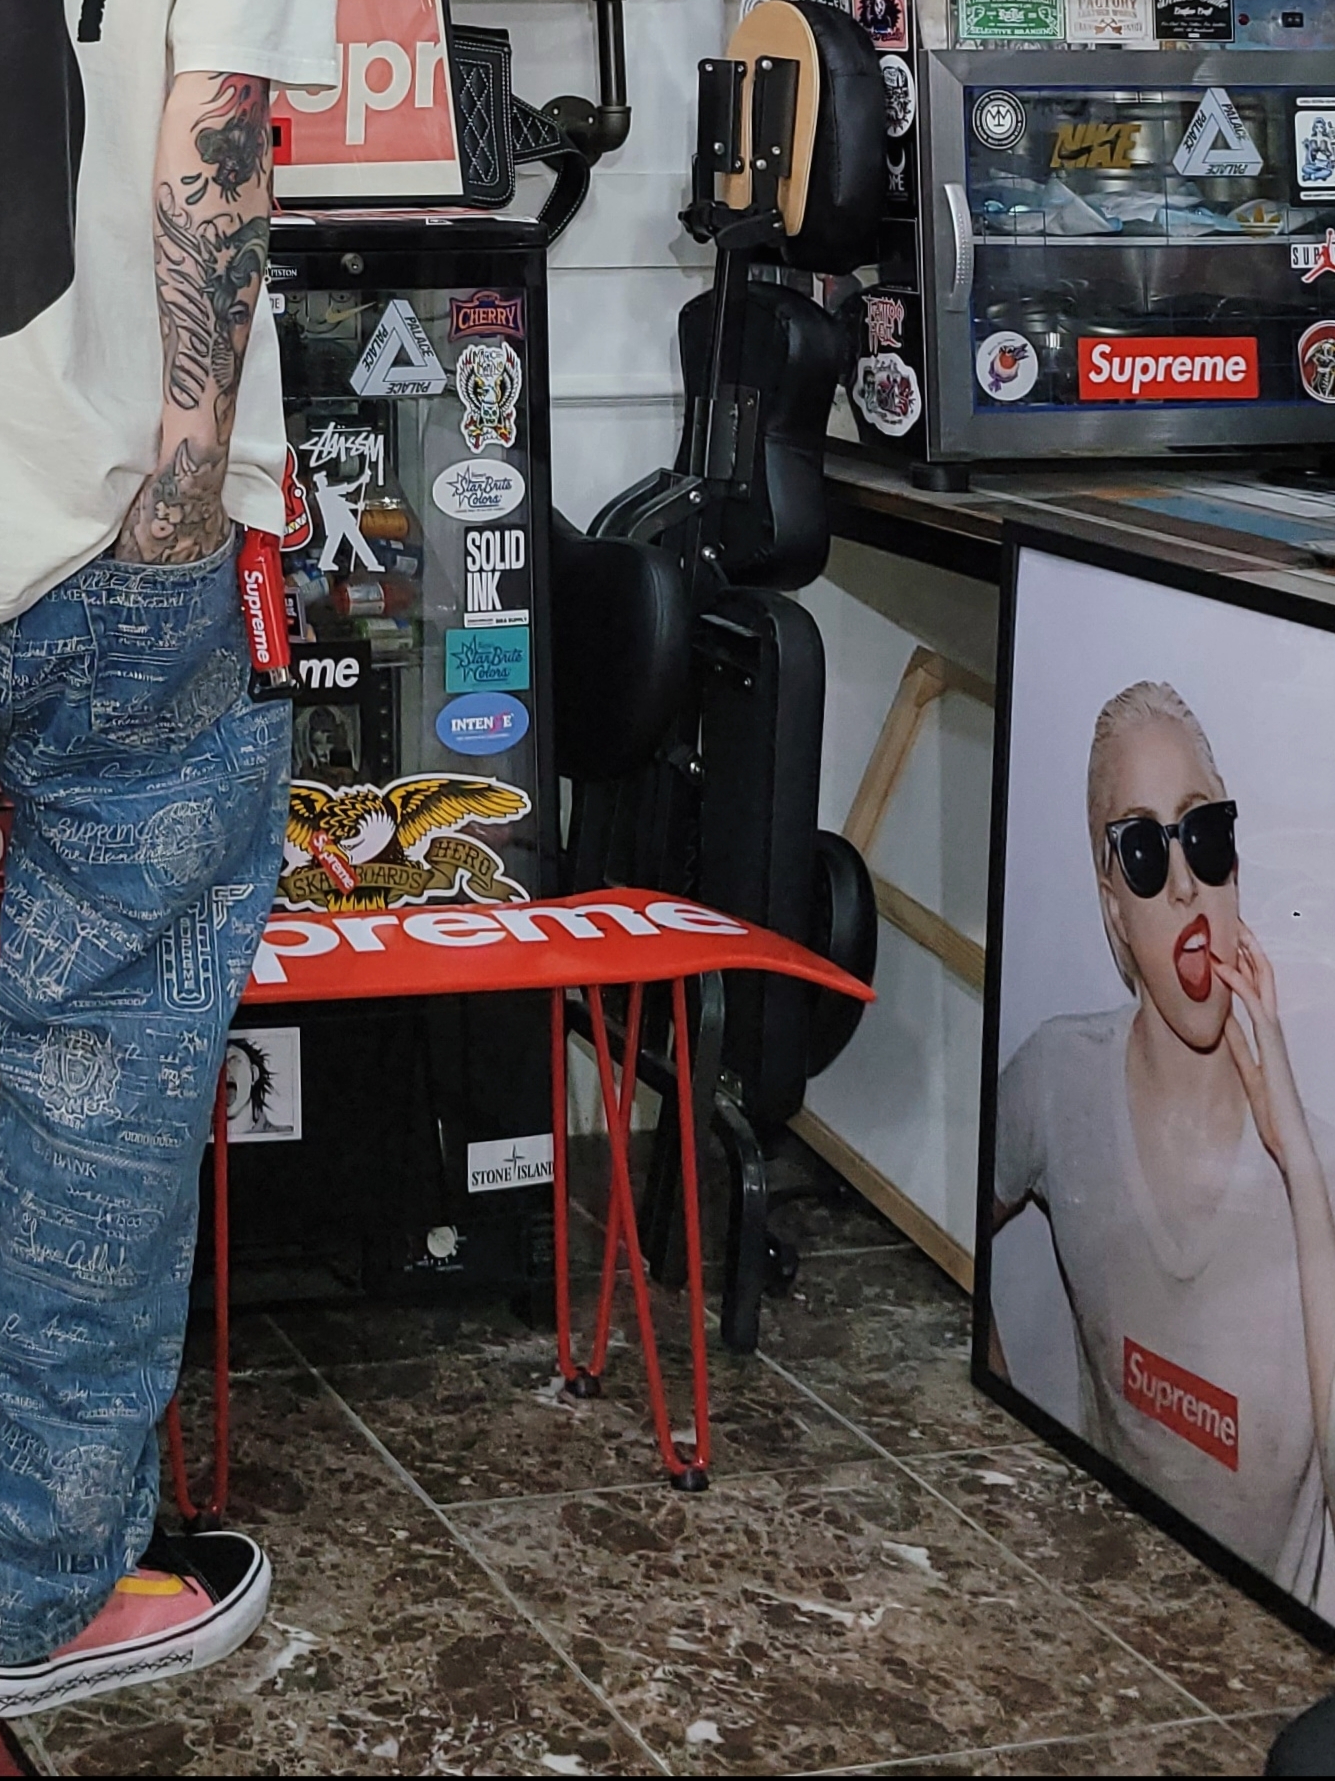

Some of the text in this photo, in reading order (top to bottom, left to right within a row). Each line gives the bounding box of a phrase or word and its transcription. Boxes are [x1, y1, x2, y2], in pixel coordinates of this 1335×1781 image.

[1183, 110, 1207, 155] PALACE
[1221, 103, 1250, 142] PALACE
[1049, 123, 1142, 169] NIKE
[1205, 164, 1249, 175] PALACE
[405, 316, 435, 358] PALACE
[458, 307, 515, 330] CHERRY
[362, 322, 388, 373] PALACE
[385, 381, 432, 395] PALACE
[1088, 344, 1247, 394] Supreme
[467, 530, 525, 572] SOLID
[467, 571, 502, 612] INK
[243, 569, 270, 664] Supreme
[434, 841, 492, 877] HERO
[472, 1168, 514, 1186] STONE
[1128, 1352, 1235, 1446] Supreme
